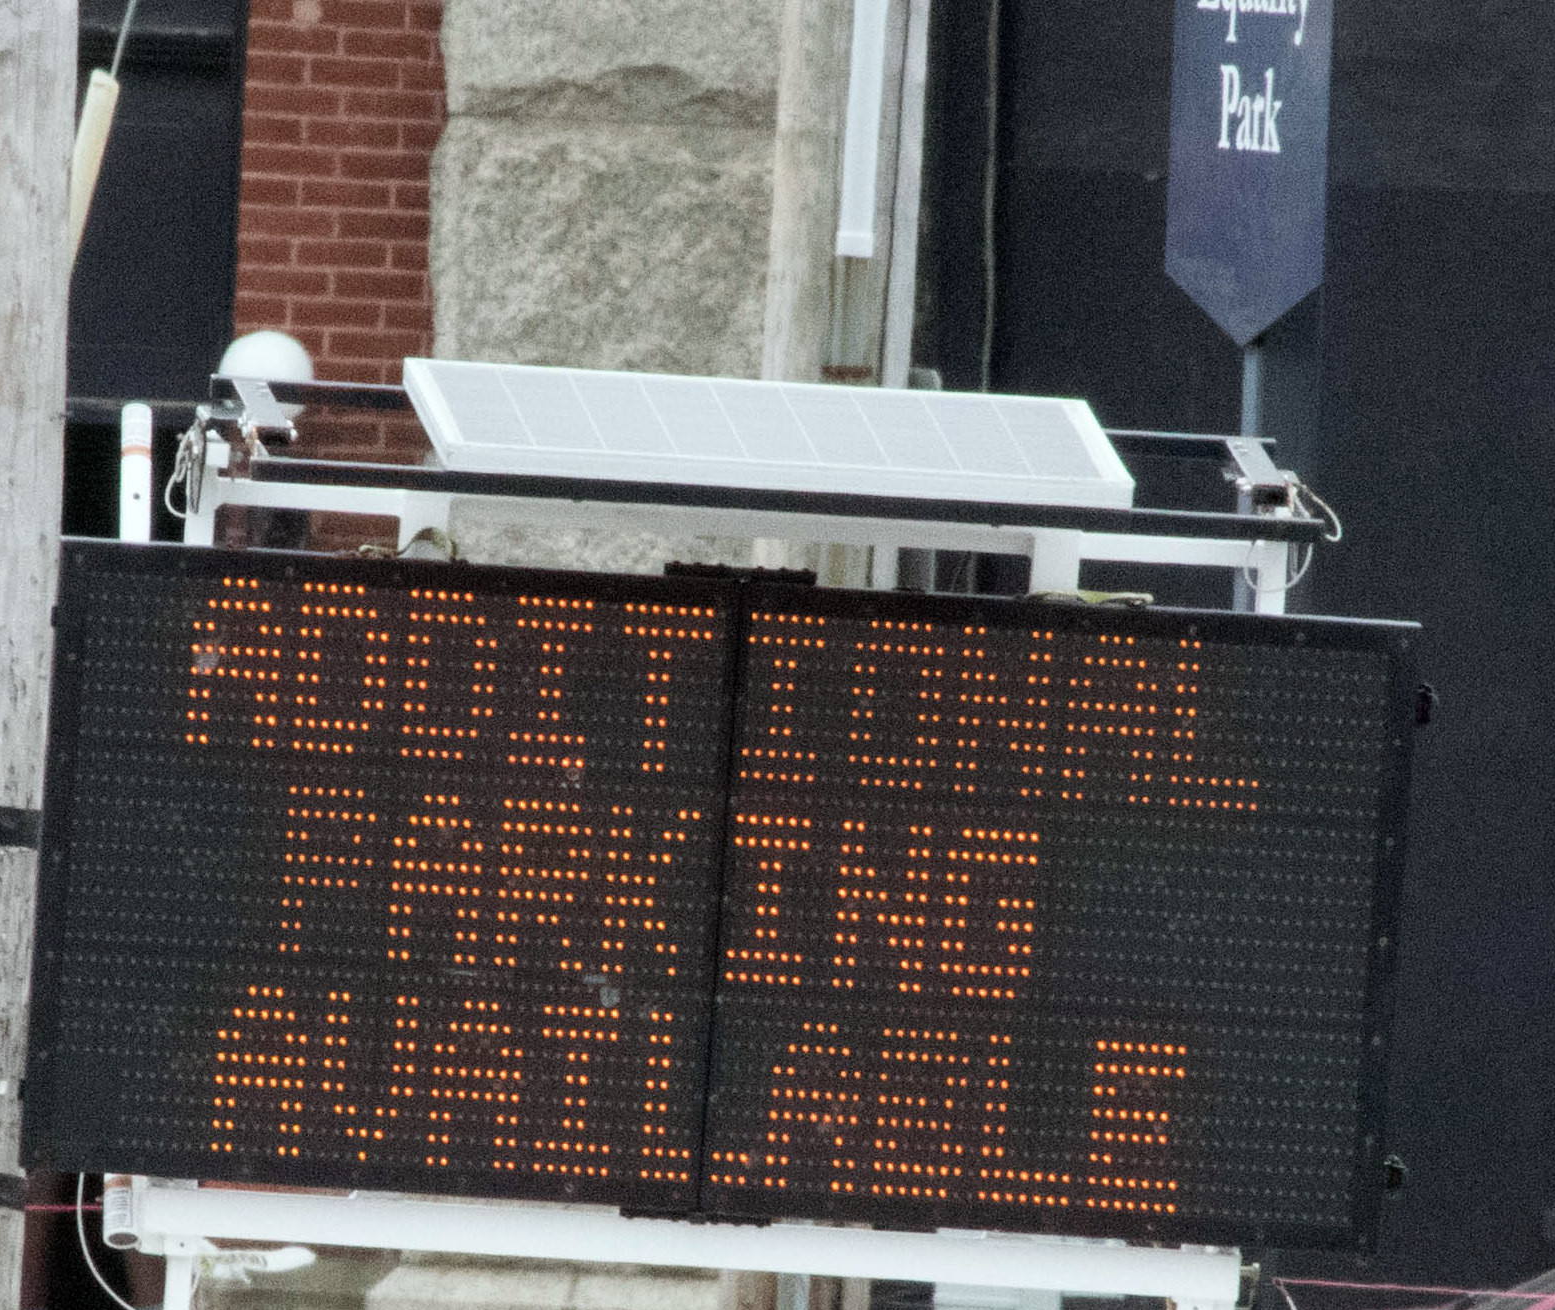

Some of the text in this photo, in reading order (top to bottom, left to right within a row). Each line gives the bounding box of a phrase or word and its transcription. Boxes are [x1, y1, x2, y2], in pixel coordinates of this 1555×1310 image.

[1218, 64, 1283, 153] Park
[186, 577, 1259, 810] ADDITIONAL
[279, 786, 1041, 1001] PARKING
[209, 987, 1187, 1214] AVAILABLE
